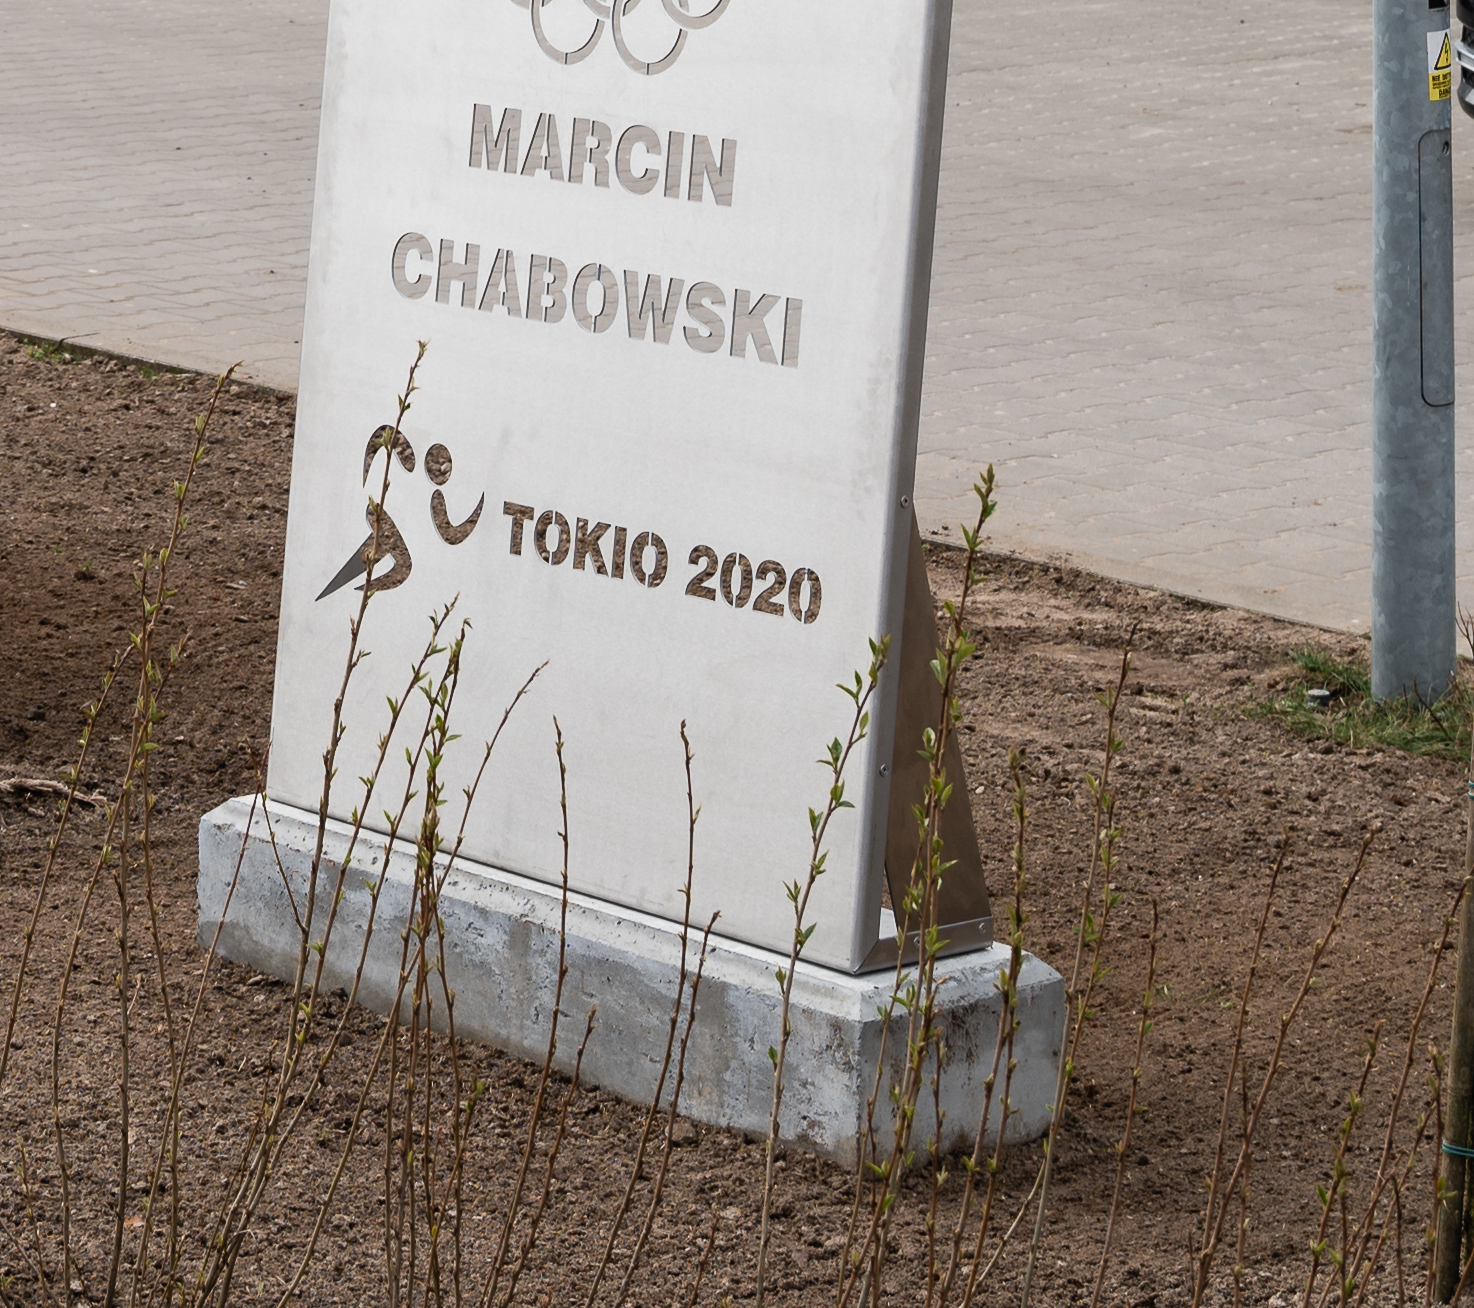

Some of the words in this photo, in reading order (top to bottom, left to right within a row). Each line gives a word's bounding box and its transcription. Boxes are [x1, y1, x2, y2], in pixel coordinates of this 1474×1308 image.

[467, 102, 738, 208] MARCIN
[390, 231, 805, 369] CHABOWSKI
[501, 500, 670, 591] TOKIO
[683, 543, 824, 626] 2020
